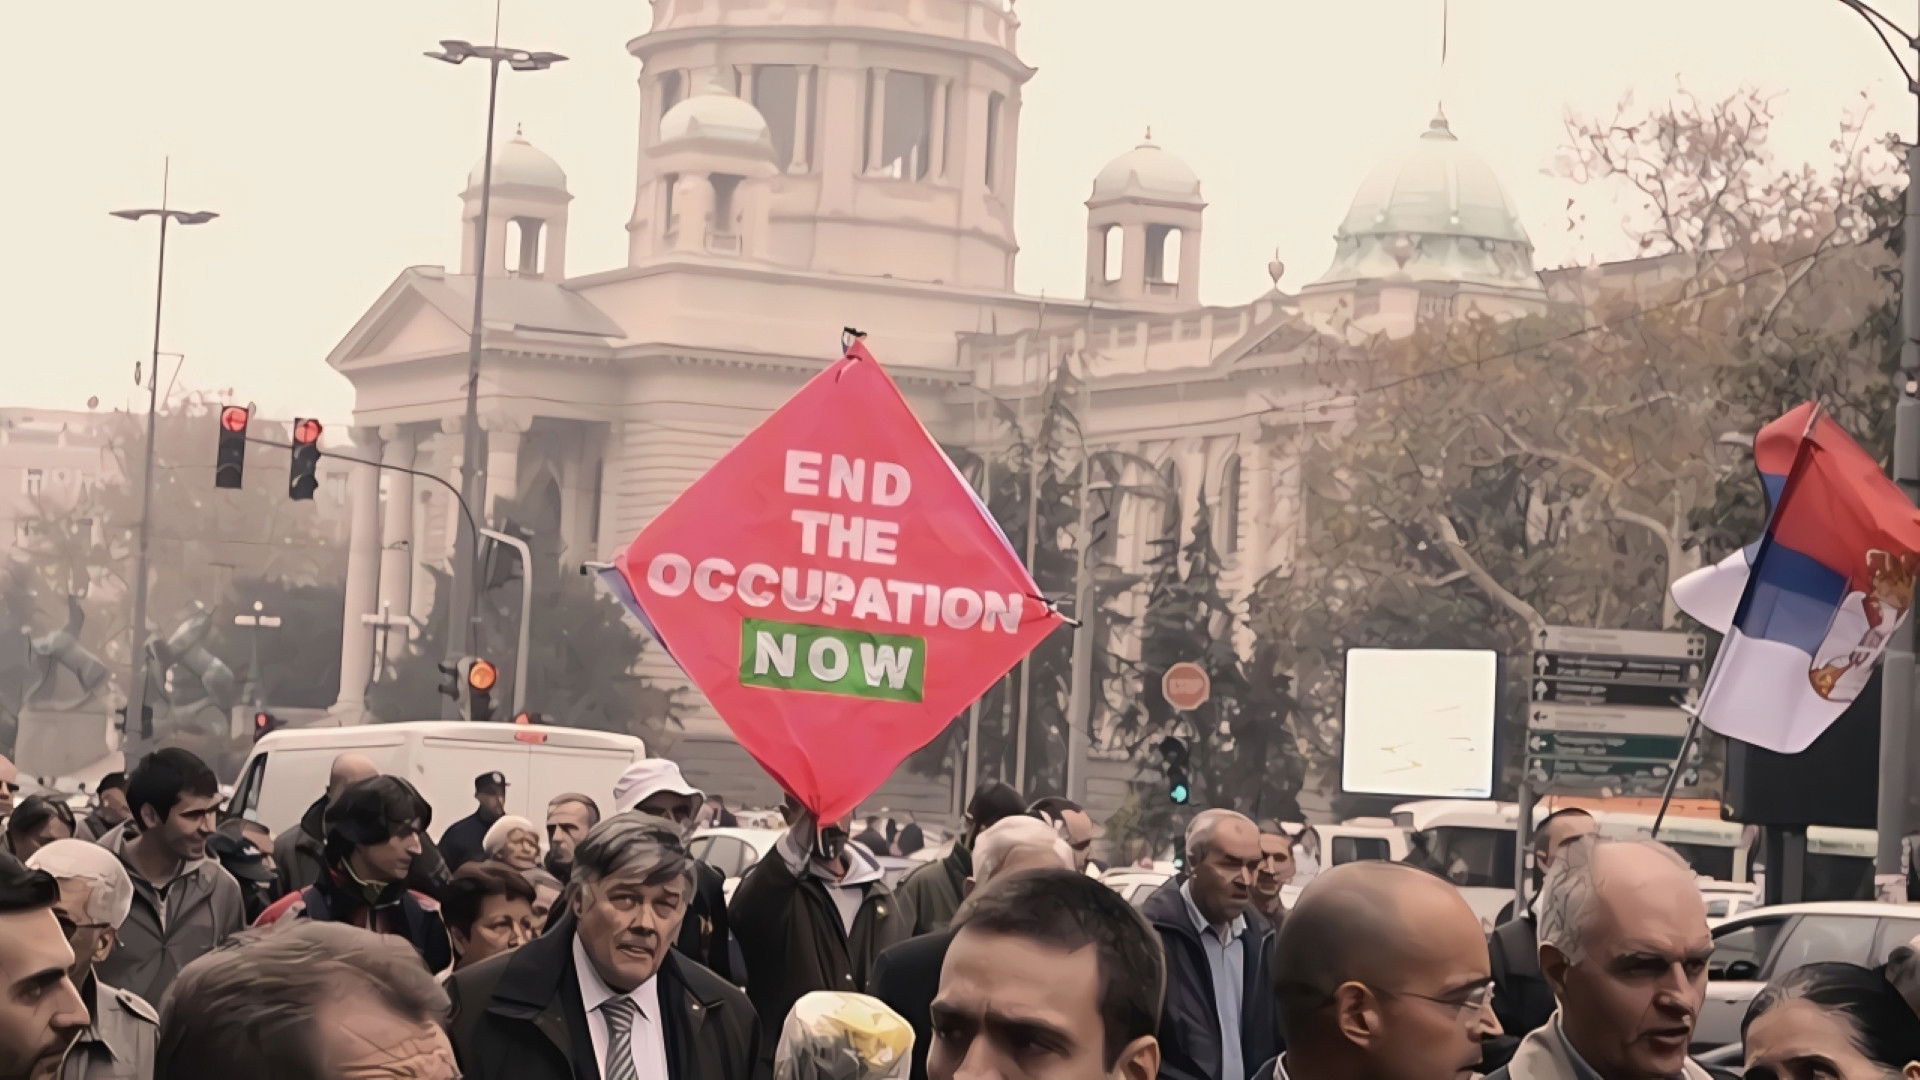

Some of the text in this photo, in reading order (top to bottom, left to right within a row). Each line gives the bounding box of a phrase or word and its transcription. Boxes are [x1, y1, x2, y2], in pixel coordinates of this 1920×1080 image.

[784, 449, 912, 506] END
[791, 509, 899, 565] THE
[647, 553, 1023, 633] OCCUPATION
[754, 631, 913, 689] NOW
